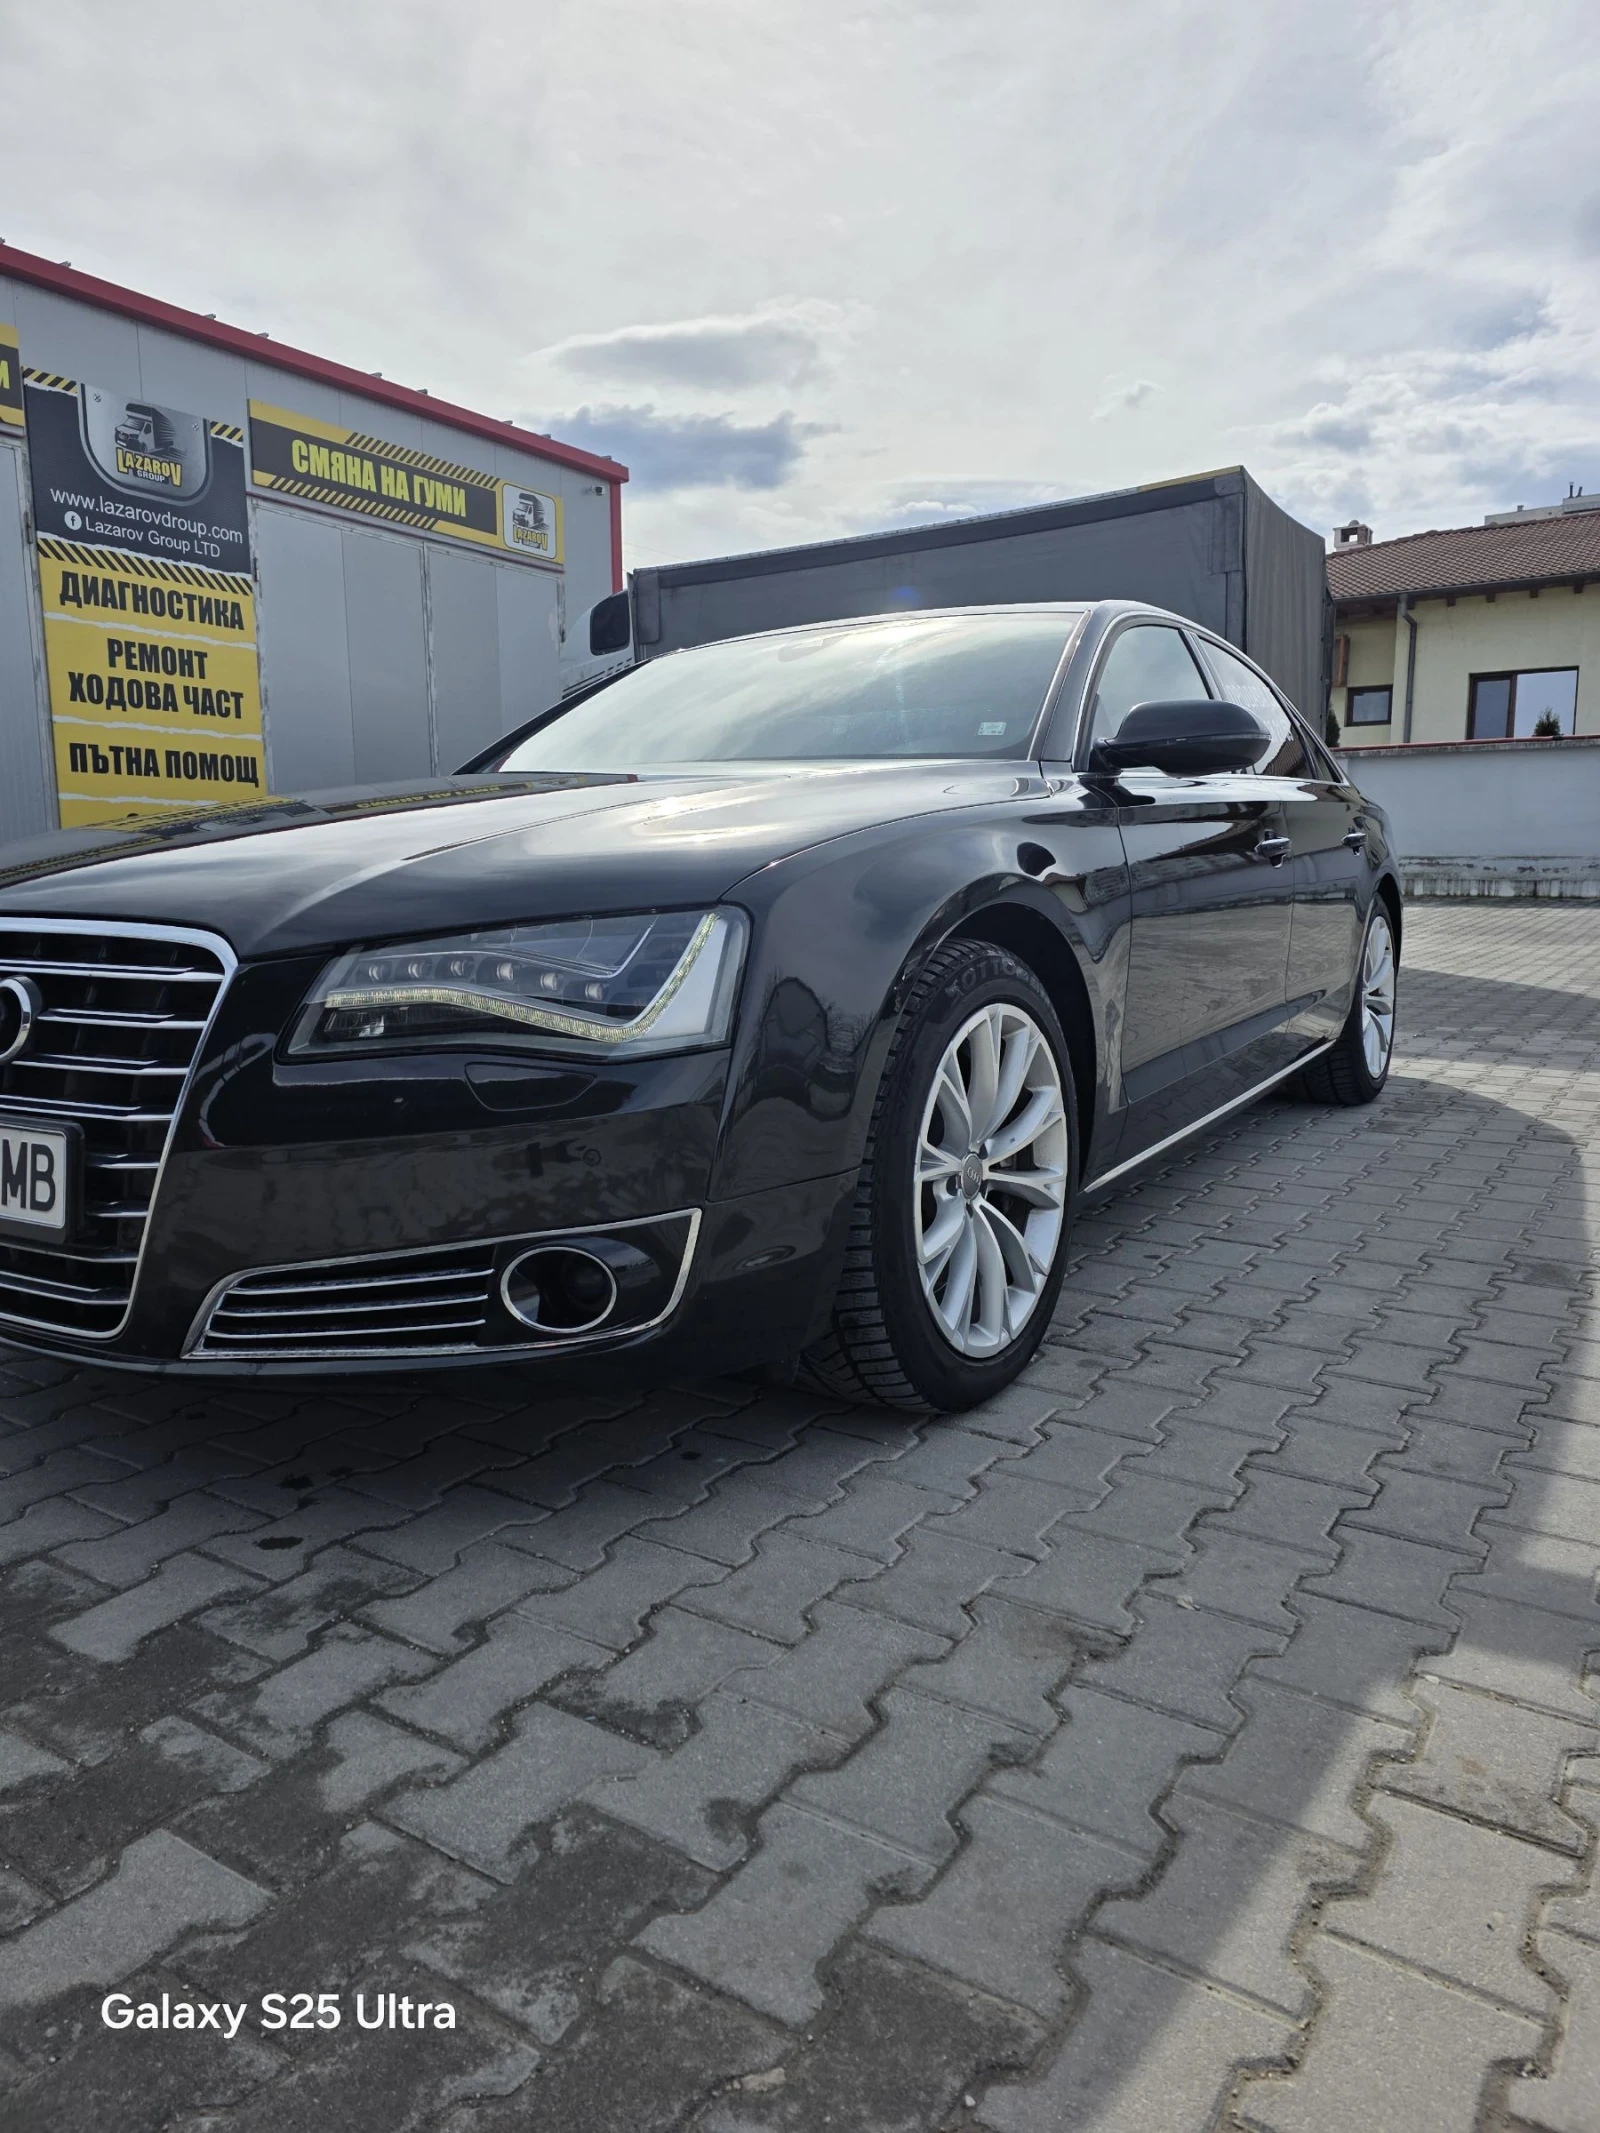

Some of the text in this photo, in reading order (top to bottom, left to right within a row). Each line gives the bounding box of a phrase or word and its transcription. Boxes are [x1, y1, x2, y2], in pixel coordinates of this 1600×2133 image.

[116, 447, 182, 487] LAZAROV
[136, 469, 166, 483] GROUP
[291, 439, 467, 517] СМЯНА НА ГУМИ
[50, 488, 244, 544] www.lazarovdroup.com
[85, 516, 144, 542] Lazarov
[147, 530, 191, 554] Group
[194, 538, 221, 558] LTD
[59, 570, 245, 631] ДИАГНОСТИКА
[106, 638, 208, 680] РЕМОНТ
[67, 671, 244, 719] ХОДОВА ЧАСТ
[69, 742, 260, 788] ПЪТНА ПОМОЩ
[1, 1139, 56, 1212] MB
